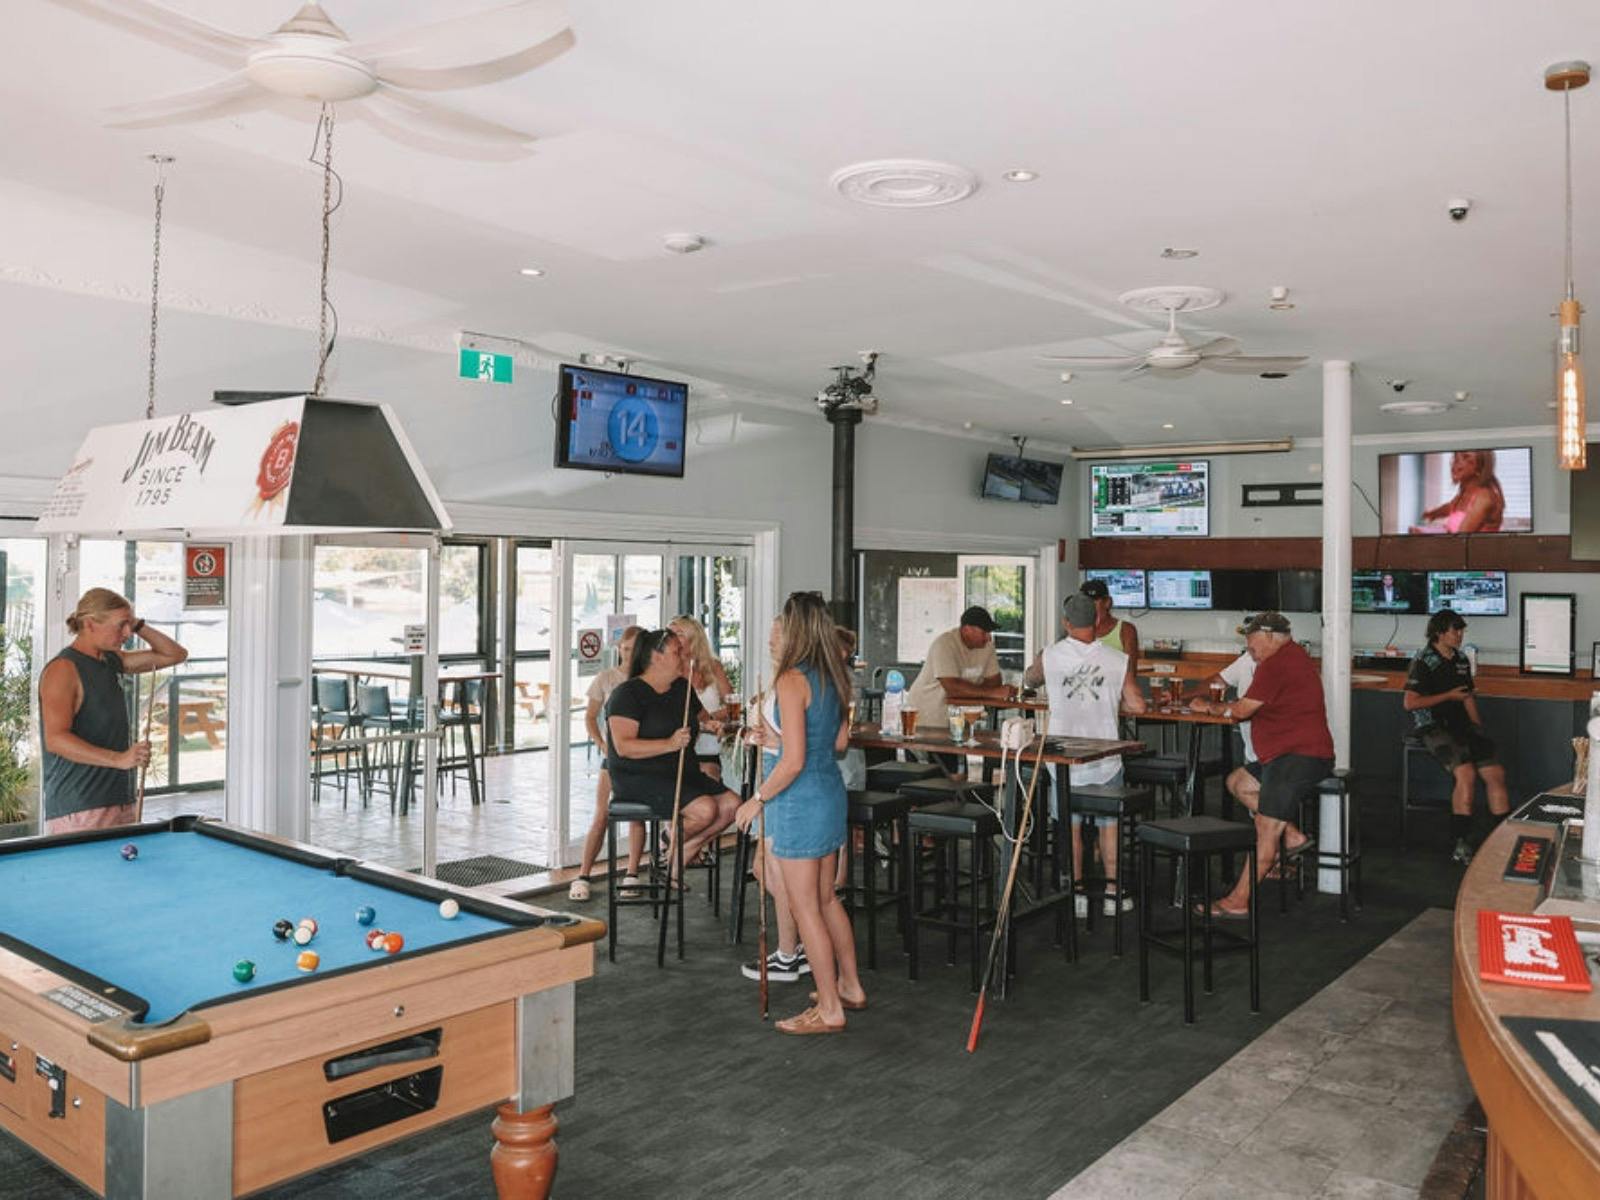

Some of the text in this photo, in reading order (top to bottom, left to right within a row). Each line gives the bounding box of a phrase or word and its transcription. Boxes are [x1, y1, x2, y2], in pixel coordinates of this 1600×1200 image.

[617, 410, 648, 448] 14
[122, 413, 216, 484] JIM BEAM
[274, 448, 290, 469] B
[139, 466, 187, 485] SINCE
[135, 488, 171, 505] 1795
